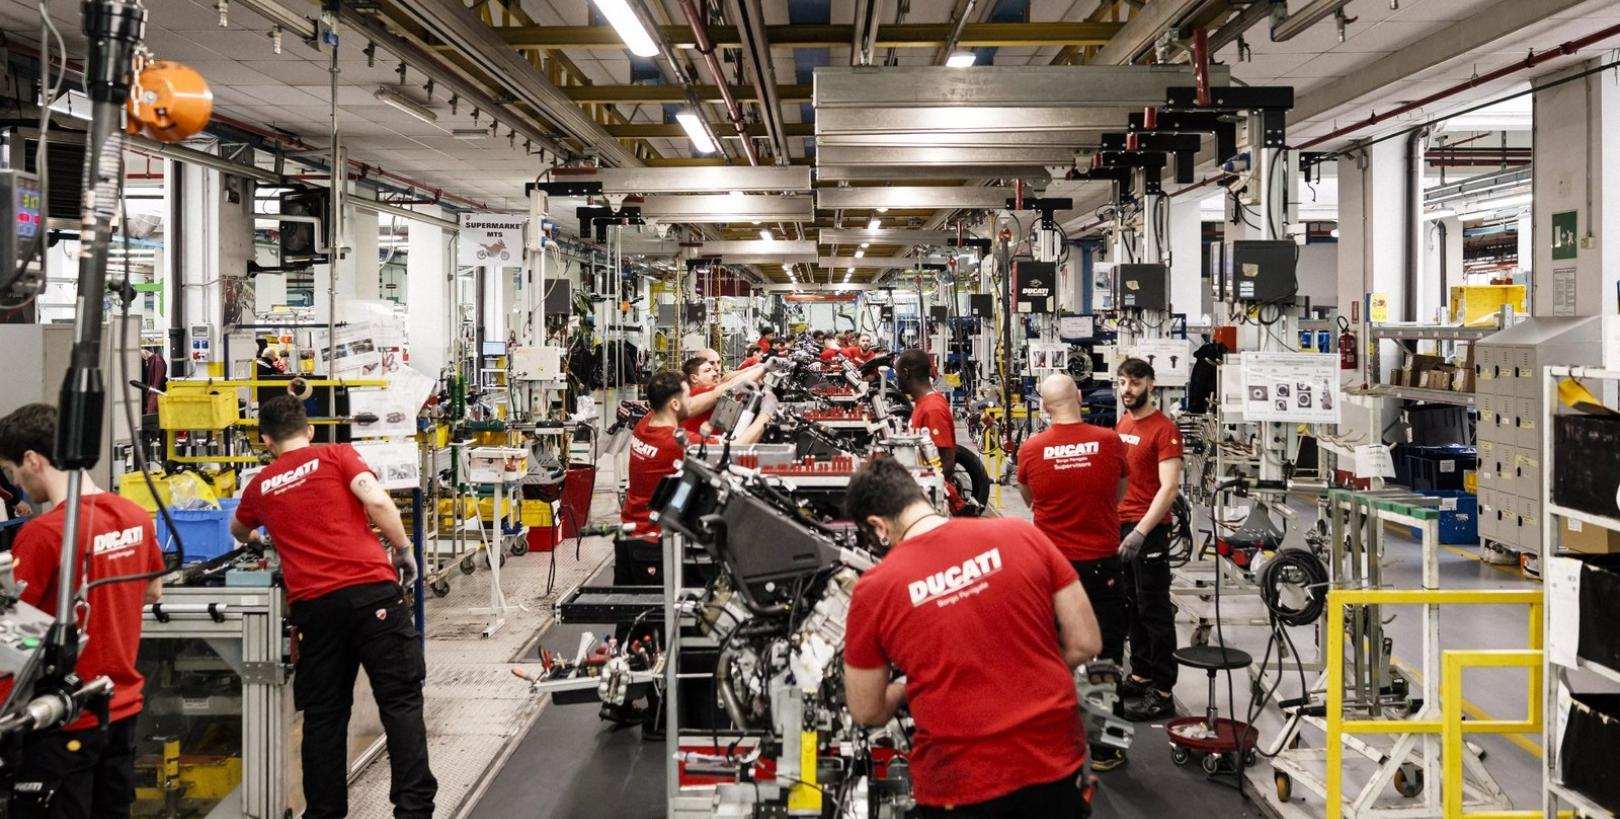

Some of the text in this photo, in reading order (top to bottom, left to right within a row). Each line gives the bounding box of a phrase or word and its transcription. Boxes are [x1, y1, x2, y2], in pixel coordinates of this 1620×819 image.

[1044, 441, 1099, 458] DUCATI
[261, 458, 319, 495] DUCATI
[908, 547, 1002, 604] DUCATI
